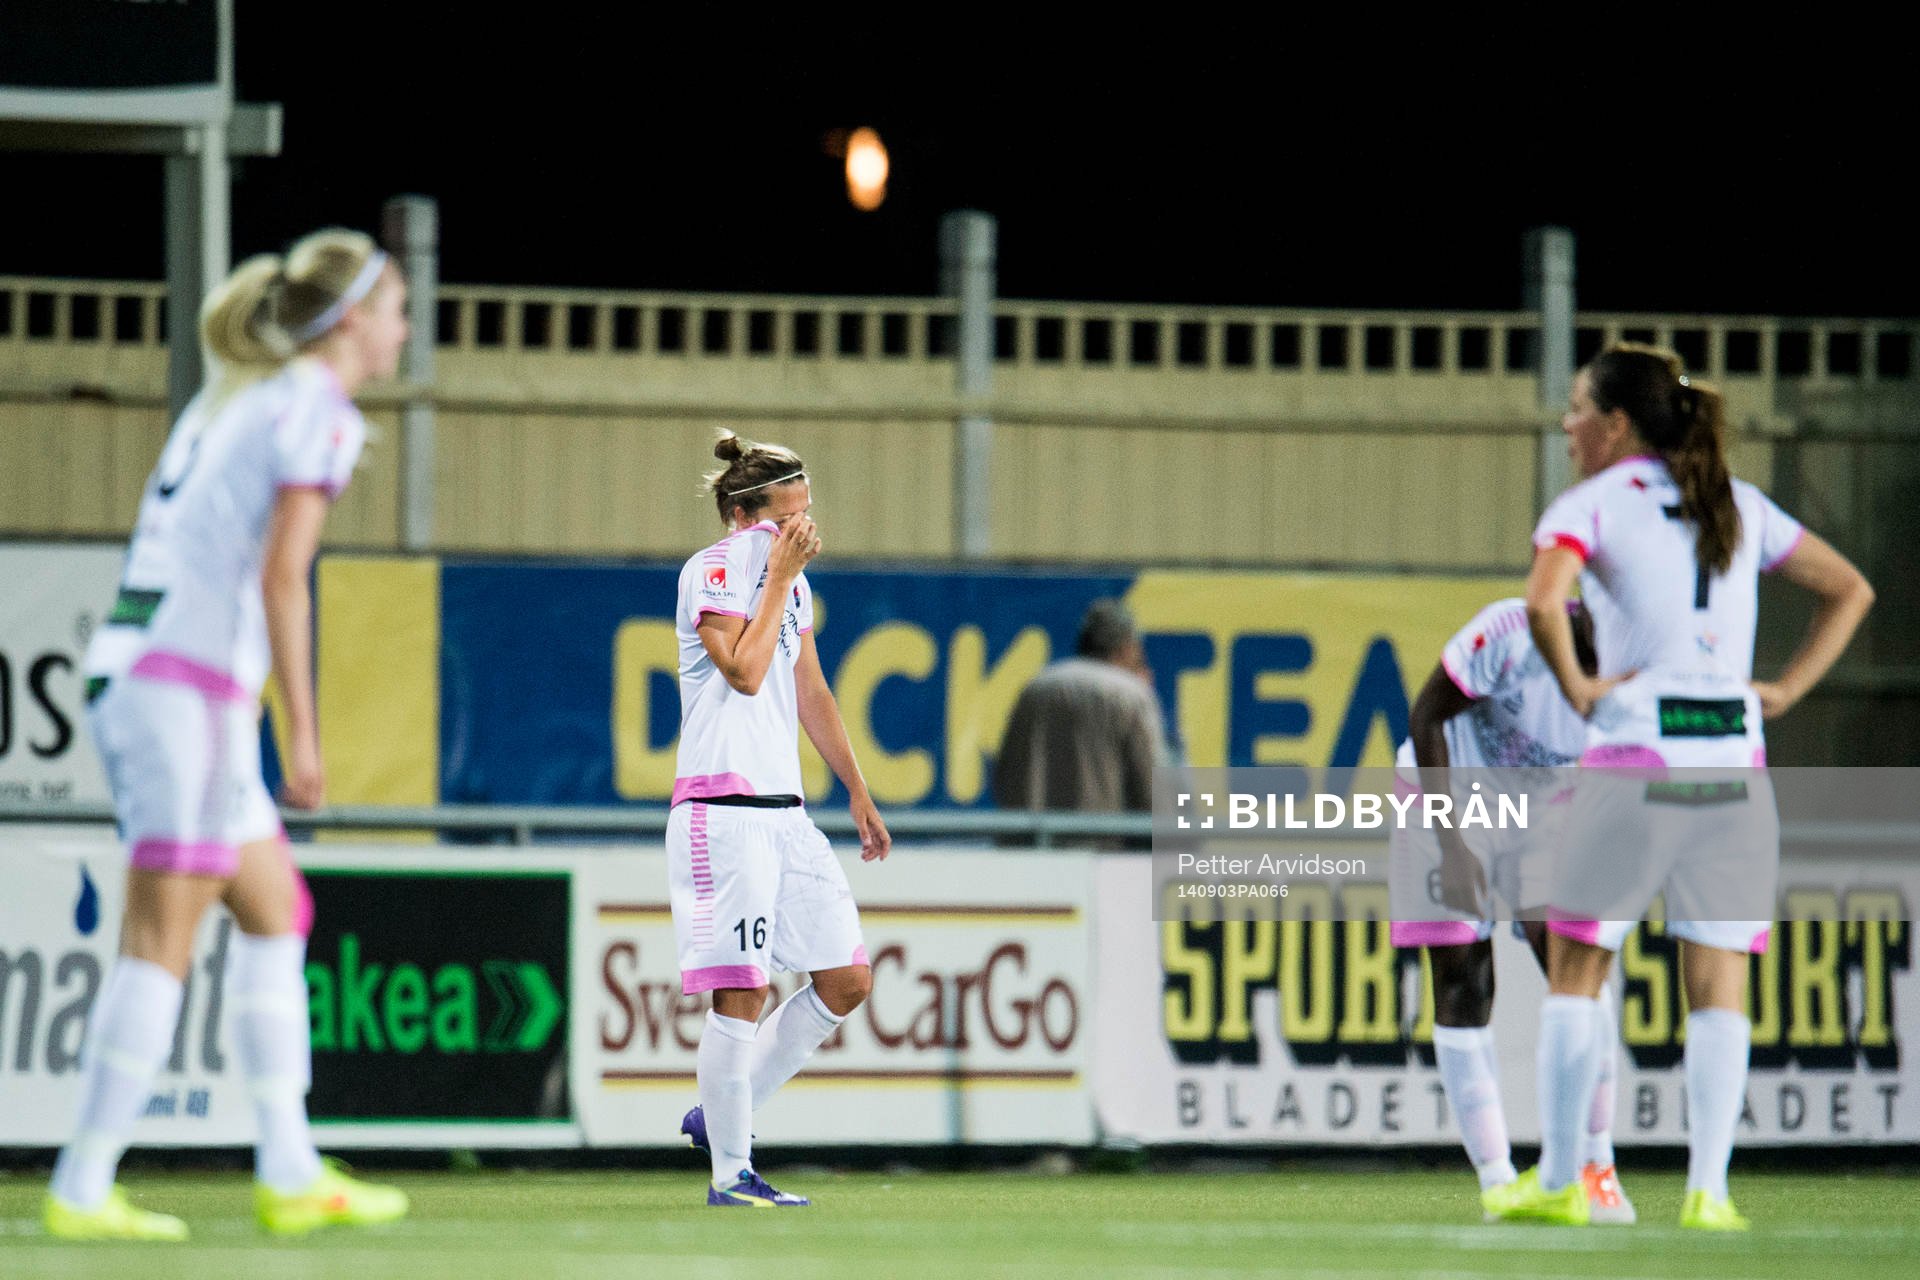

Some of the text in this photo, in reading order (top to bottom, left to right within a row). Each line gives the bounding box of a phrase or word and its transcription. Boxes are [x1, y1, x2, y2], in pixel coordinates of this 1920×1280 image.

[612, 593, 1052, 806] DCK
[734, 916, 767, 952] 16
[1621, 882, 1909, 1066] SORT
[866, 942, 1078, 1053] CarGo
[1177, 1081, 1448, 1131] BLADET
[1634, 1083, 1899, 1131] BDET
